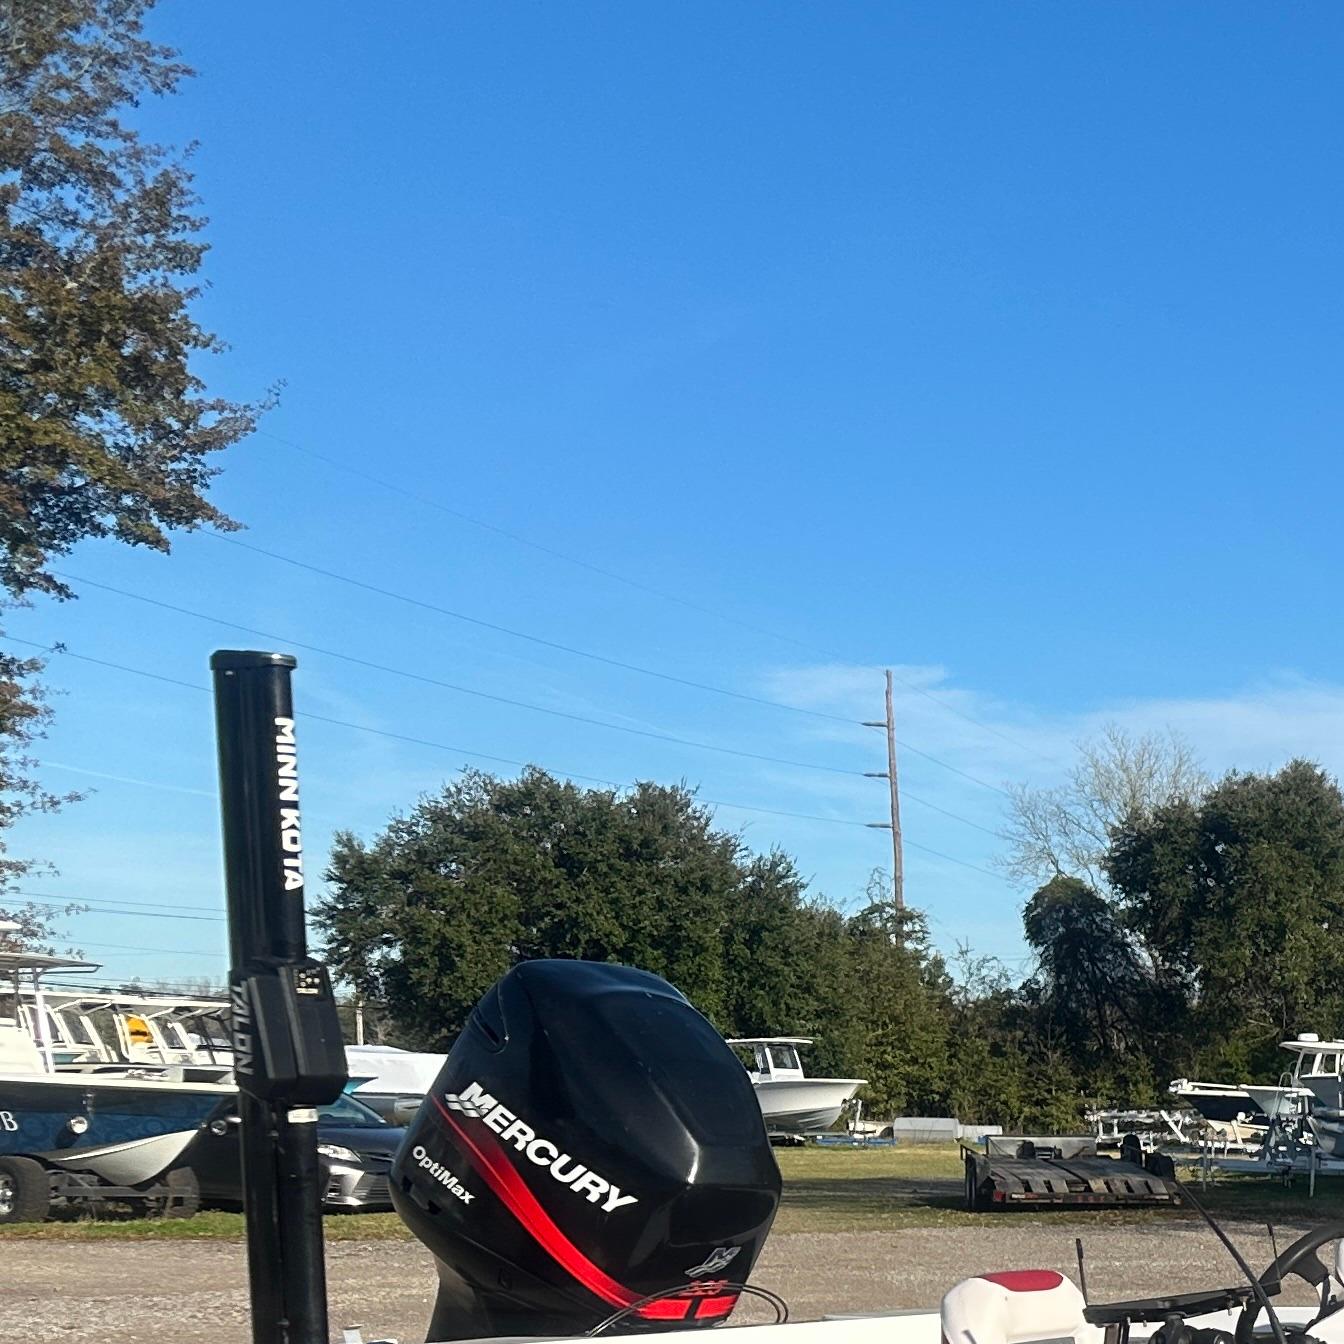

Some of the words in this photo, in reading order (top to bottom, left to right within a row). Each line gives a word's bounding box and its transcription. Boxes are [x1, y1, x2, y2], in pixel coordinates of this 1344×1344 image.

[274, 716, 299, 801] MINN
[280, 808, 304, 891] KOTA
[229, 981, 254, 1075] TALON
[412, 1145, 476, 1205] OptiMax
[446, 1081, 639, 1213] MERCURY
